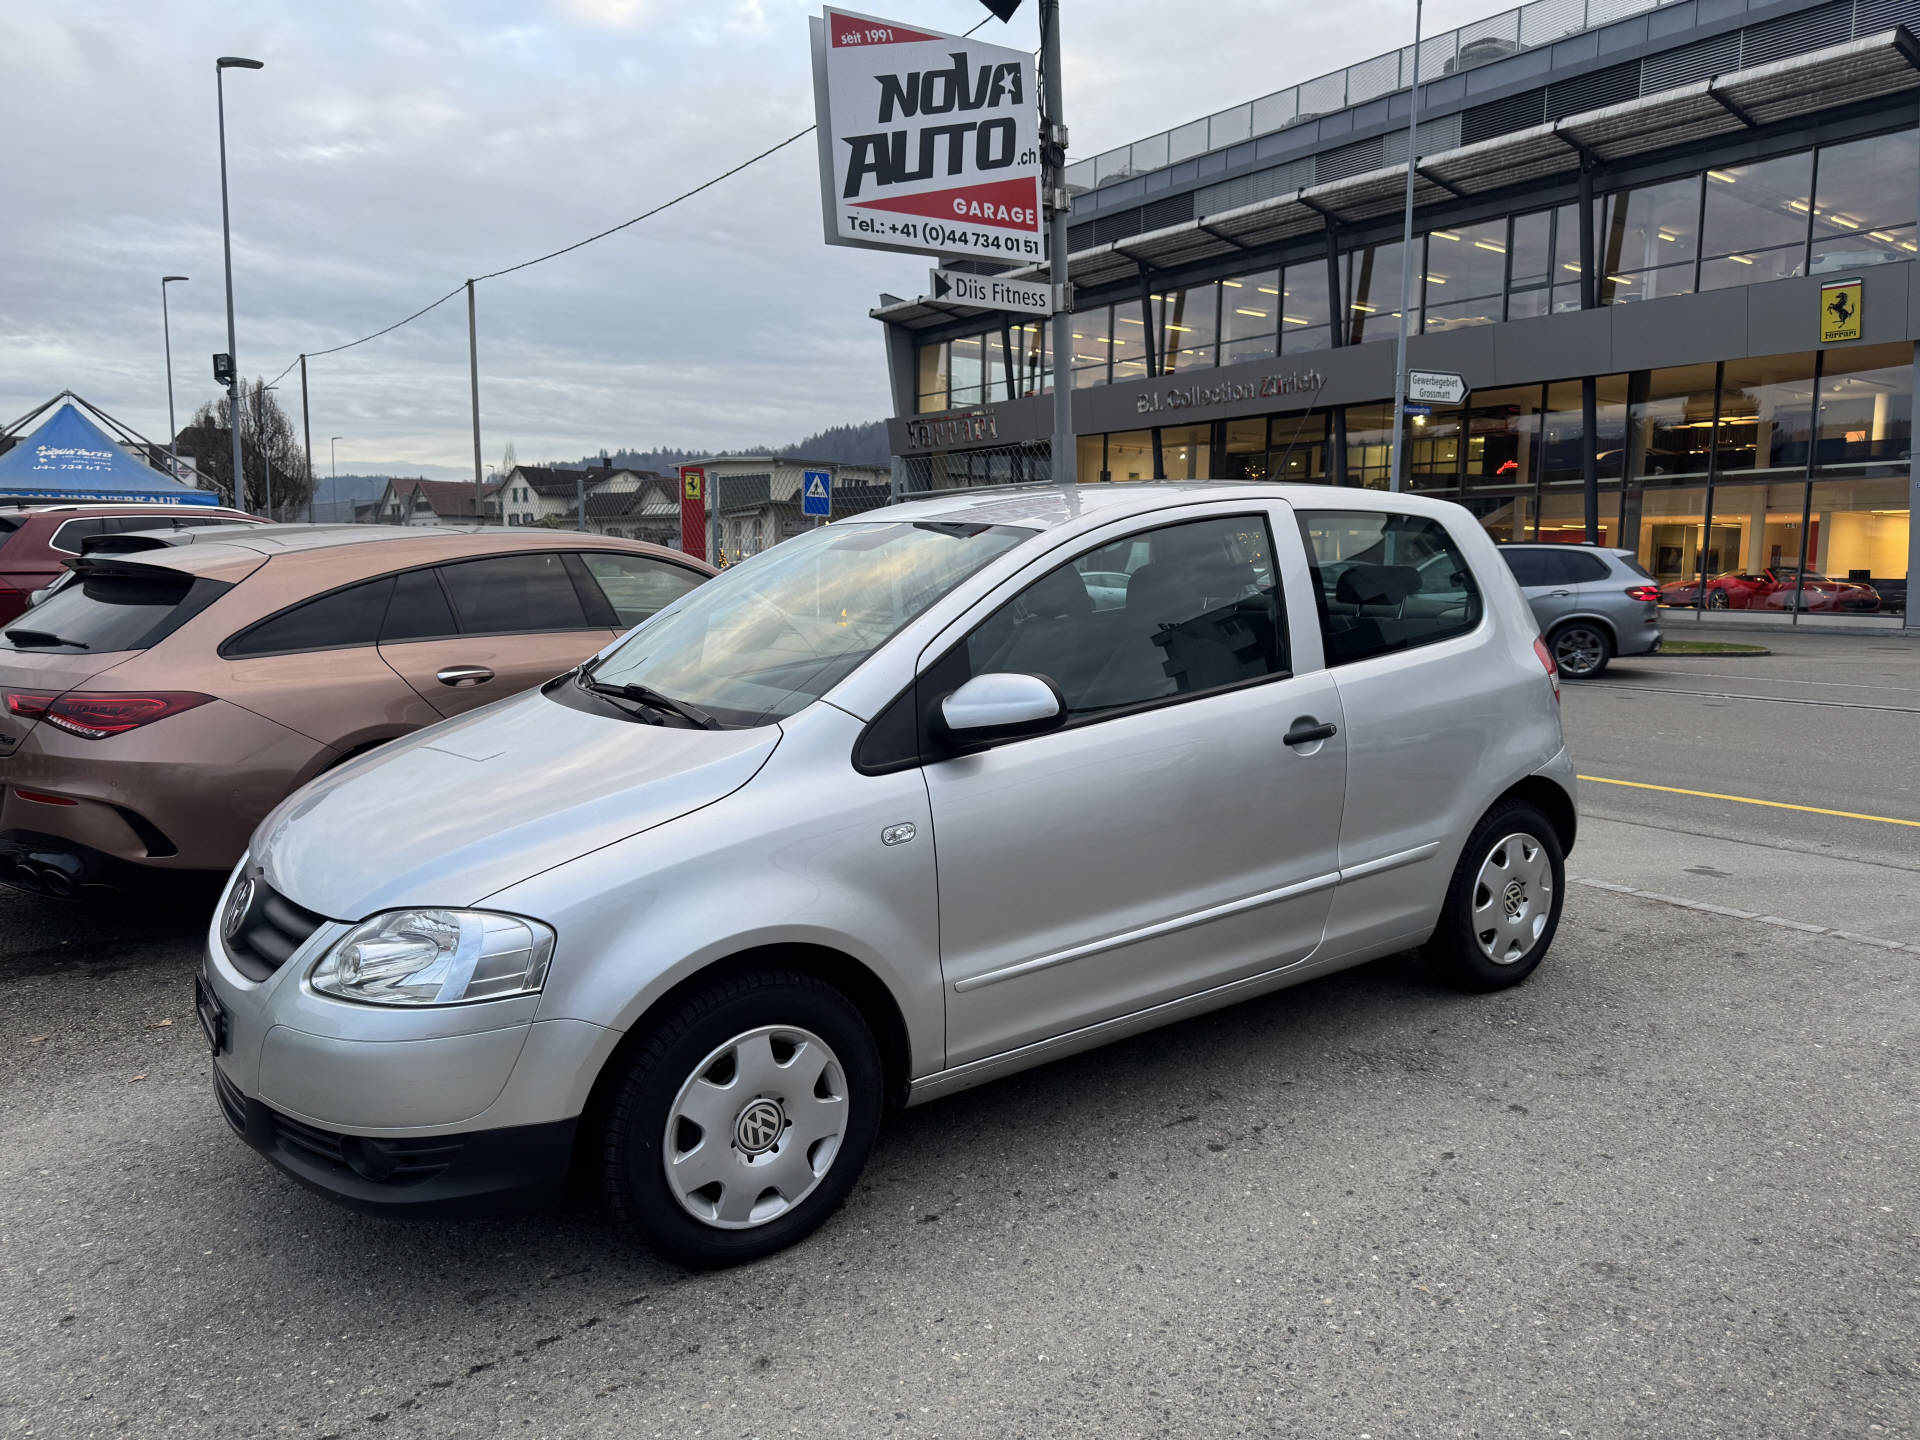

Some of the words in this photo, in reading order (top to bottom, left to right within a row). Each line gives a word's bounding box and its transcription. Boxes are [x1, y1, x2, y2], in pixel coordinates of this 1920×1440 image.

[841, 29, 862, 45] seit
[864, 29, 894, 43] 1991
[873, 52, 1023, 124] NOVA
[953, 198, 1035, 225] GARAGE
[847, 215, 885, 234] Tel.:
[889, 223, 918, 239] +41
[972, 232, 1001, 250] 734
[1004, 237, 1020, 253] 01
[1024, 239, 1039, 255] 51
[956, 278, 986, 300] Diis
[992, 283, 1046, 307] Fitness
[1825, 329, 1857, 339] Ferrari
[1167, 380, 1255, 409] Collection
[1259, 368, 1322, 398] Zürich
[1412, 374, 1458, 389] Gewerbegebiet
[1419, 387, 1451, 399] Grossmatt
